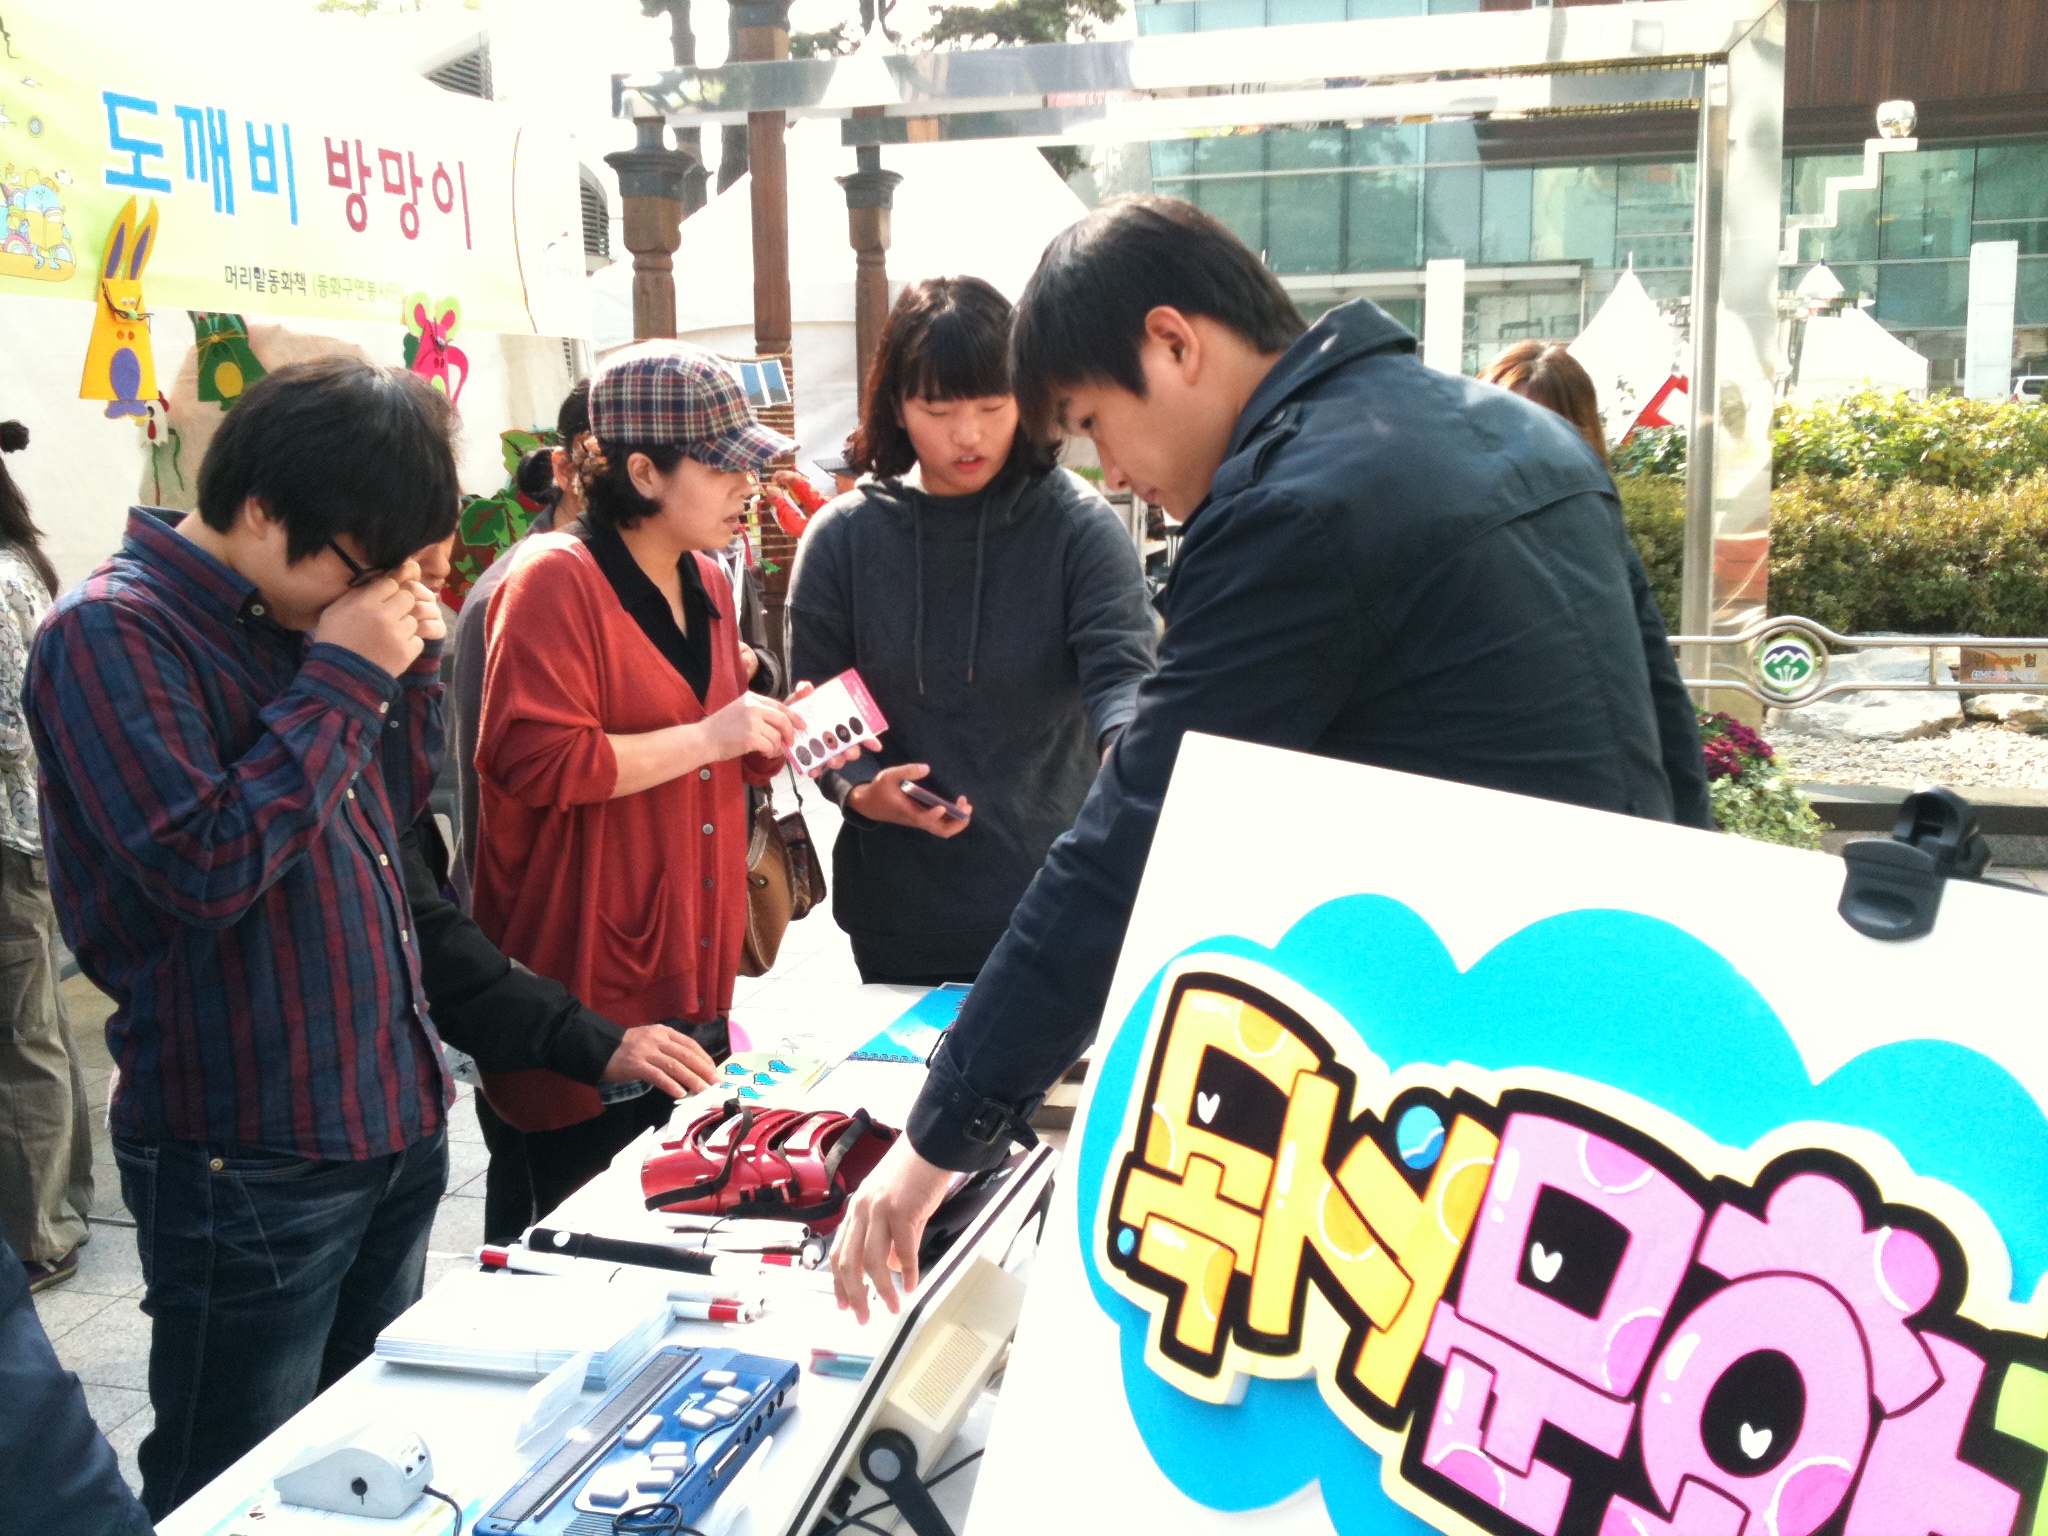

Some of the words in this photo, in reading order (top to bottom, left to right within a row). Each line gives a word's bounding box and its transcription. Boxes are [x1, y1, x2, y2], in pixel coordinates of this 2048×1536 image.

[102, 90, 298, 226] 도깨비
[323, 135, 472, 251] 방망이
[224, 264, 307, 296] 머리맡동화책
